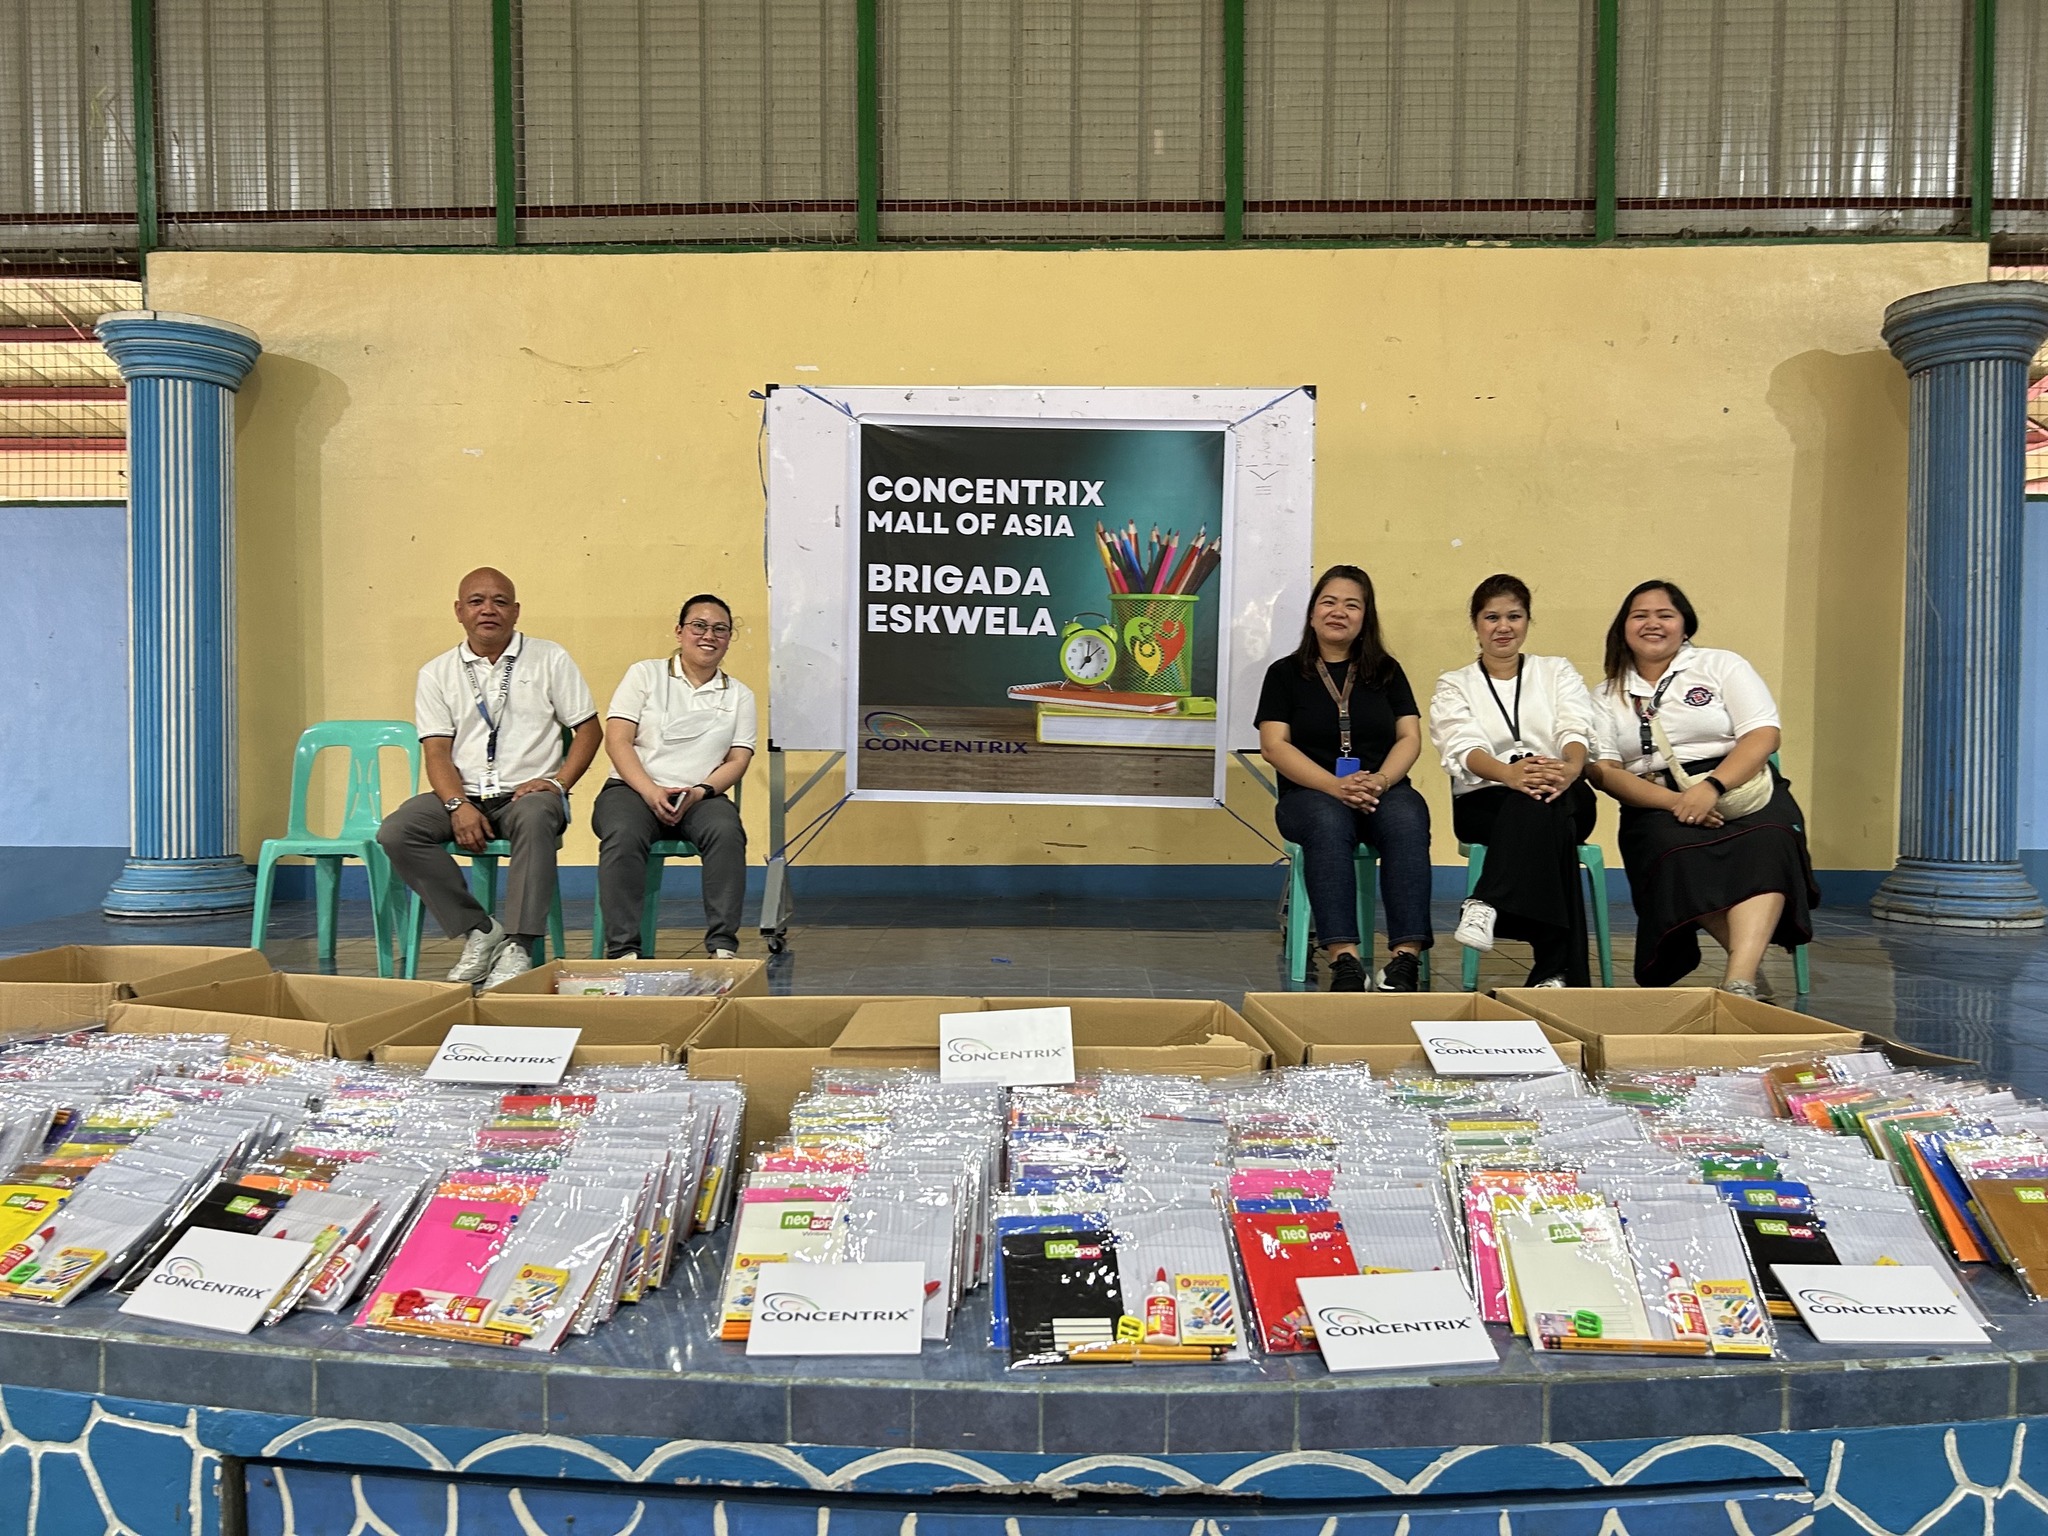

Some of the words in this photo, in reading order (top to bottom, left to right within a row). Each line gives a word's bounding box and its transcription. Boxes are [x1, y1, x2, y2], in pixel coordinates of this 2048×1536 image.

[867, 475, 1105, 507] CONCENTRIX
[867, 510, 950, 535] MALL
[955, 512, 996, 536] OF
[1001, 514, 1075, 537] ASIA
[867, 563, 1051, 597] BRIGADA
[867, 604, 1057, 637] ESKWELA
[864, 738, 1028, 754] CONCENTRIX
[442, 1054, 557, 1064] CONCENTRIX
[948, 1047, 1062, 1063] CONCENTRIX
[1434, 1047, 1546, 1055] CONCENTRIX
[455, 1215, 481, 1227] neo
[476, 1222, 498, 1233] pop
[785, 1214, 810, 1226] neo
[1281, 1228, 1307, 1241] neo
[1309, 1231, 1331, 1242] pop
[1788, 1227, 1813, 1237] pop
[1049, 1243, 1076, 1255] neo
[154, 1273, 267, 1299] CONCENTRIX
[760, 1310, 909, 1322] CONCENTRIX
[1809, 1304, 1957, 1315] CONCENTRIX
[1326, 1318, 1471, 1337] CONCENTRIX
